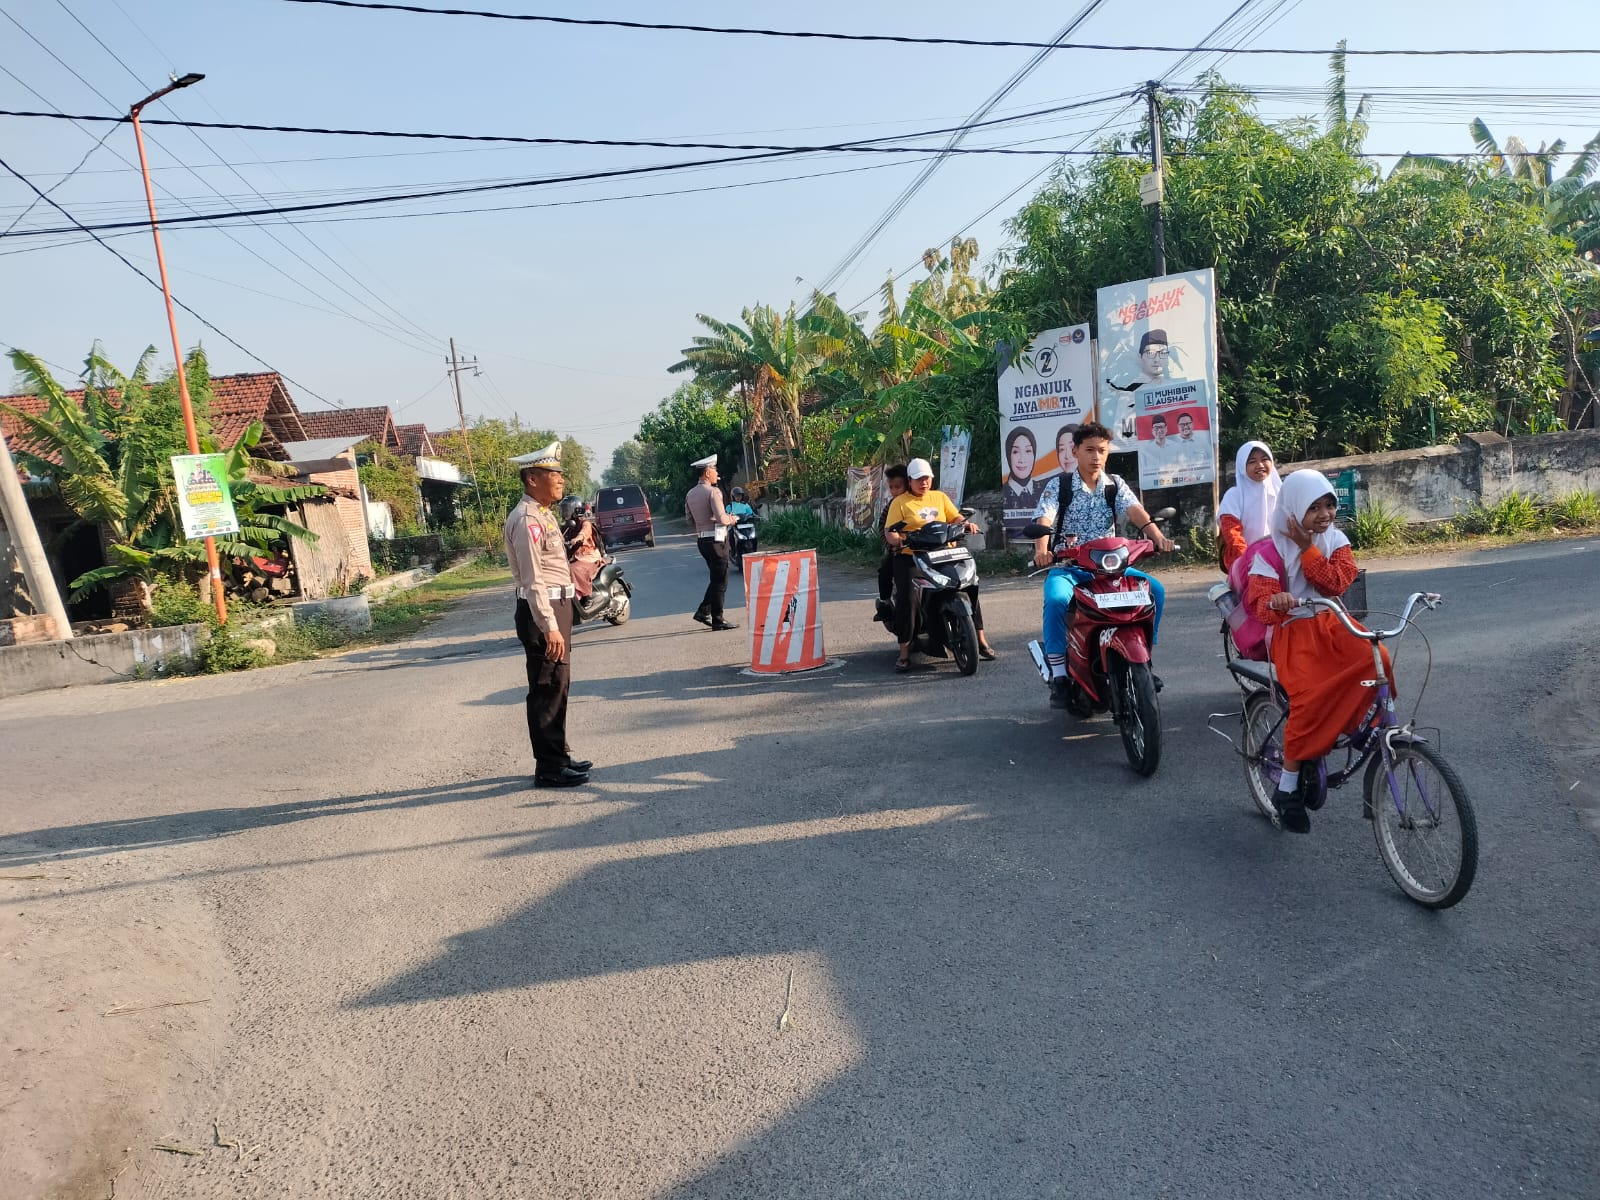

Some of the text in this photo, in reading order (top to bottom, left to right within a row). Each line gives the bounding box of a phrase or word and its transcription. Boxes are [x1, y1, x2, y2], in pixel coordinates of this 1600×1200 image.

[1119, 286, 1185, 317] NGANJUK
[1122, 299, 1181, 326] DIGDAYA
[1040, 351, 1052, 373] 2
[1014, 379, 1072, 399] NGANJUK
[1154, 385, 1197, 399] MUHIBBIN
[1156, 394, 1190, 405] AUSHAF
